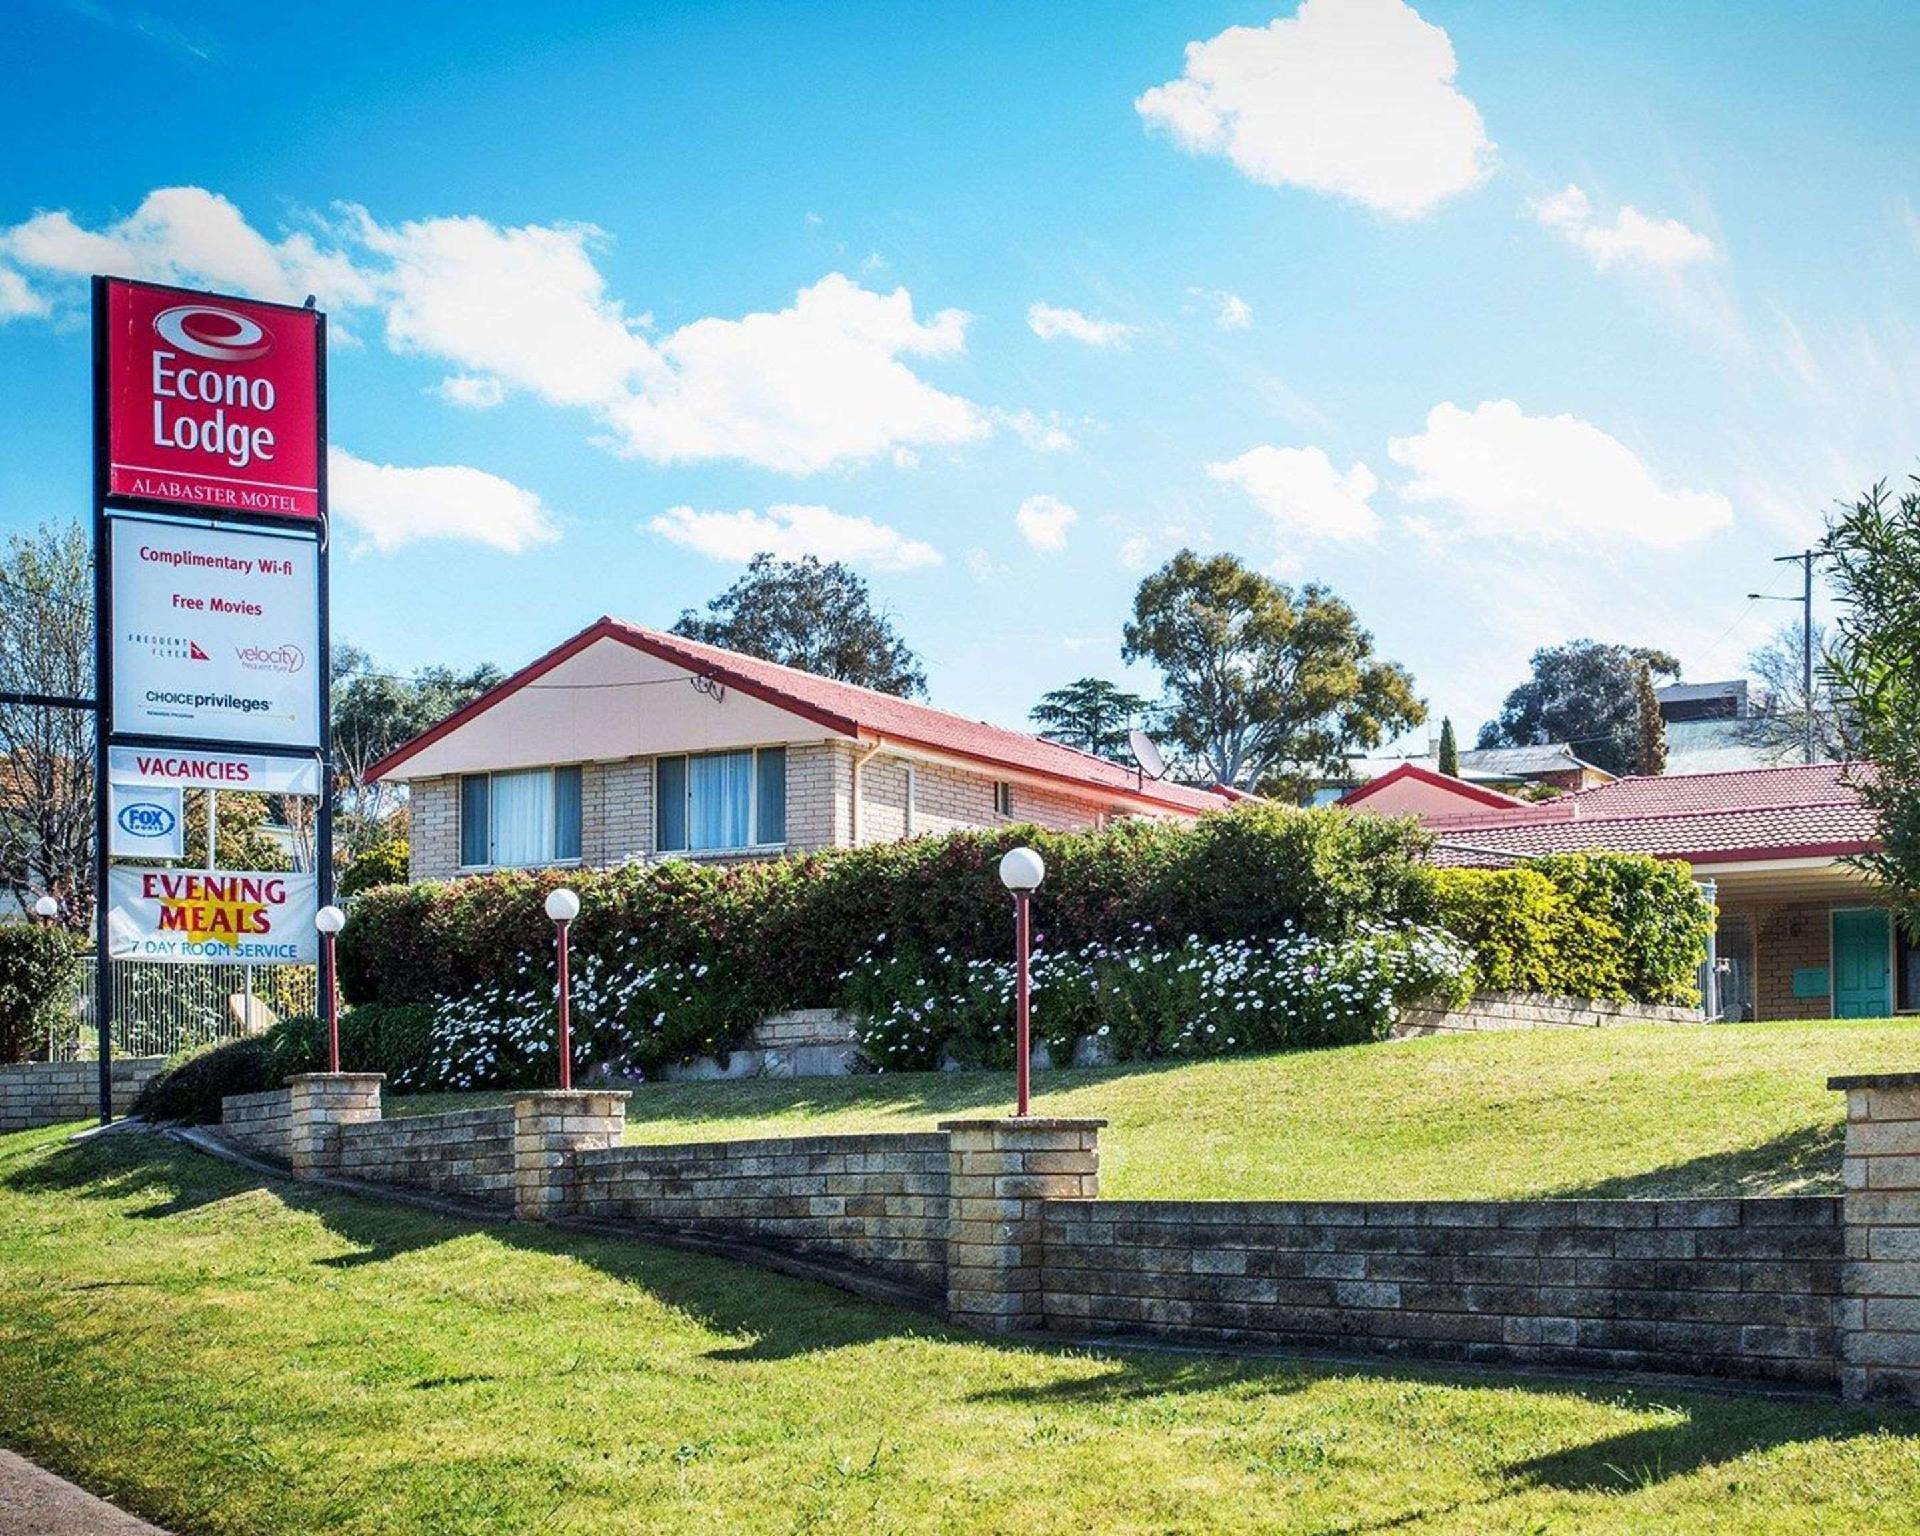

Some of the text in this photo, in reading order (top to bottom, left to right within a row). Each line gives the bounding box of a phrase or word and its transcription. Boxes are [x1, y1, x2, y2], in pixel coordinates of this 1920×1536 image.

[153, 350, 275, 411] Econo
[154, 400, 275, 467] Lodge
[132, 479, 300, 512] ALABASTER MOTEL
[140, 546, 293, 576] Complimentary Wi-fi
[172, 594, 262, 616] Free Movies
[235, 644, 305, 673] velocity
[137, 757, 250, 782] VACANCIES
[129, 809, 163, 826] FOX
[143, 874, 286, 904] EVENING
[158, 906, 271, 934] MEALS
[131, 940, 297, 958] 7 DAY ROOM SERVICE
